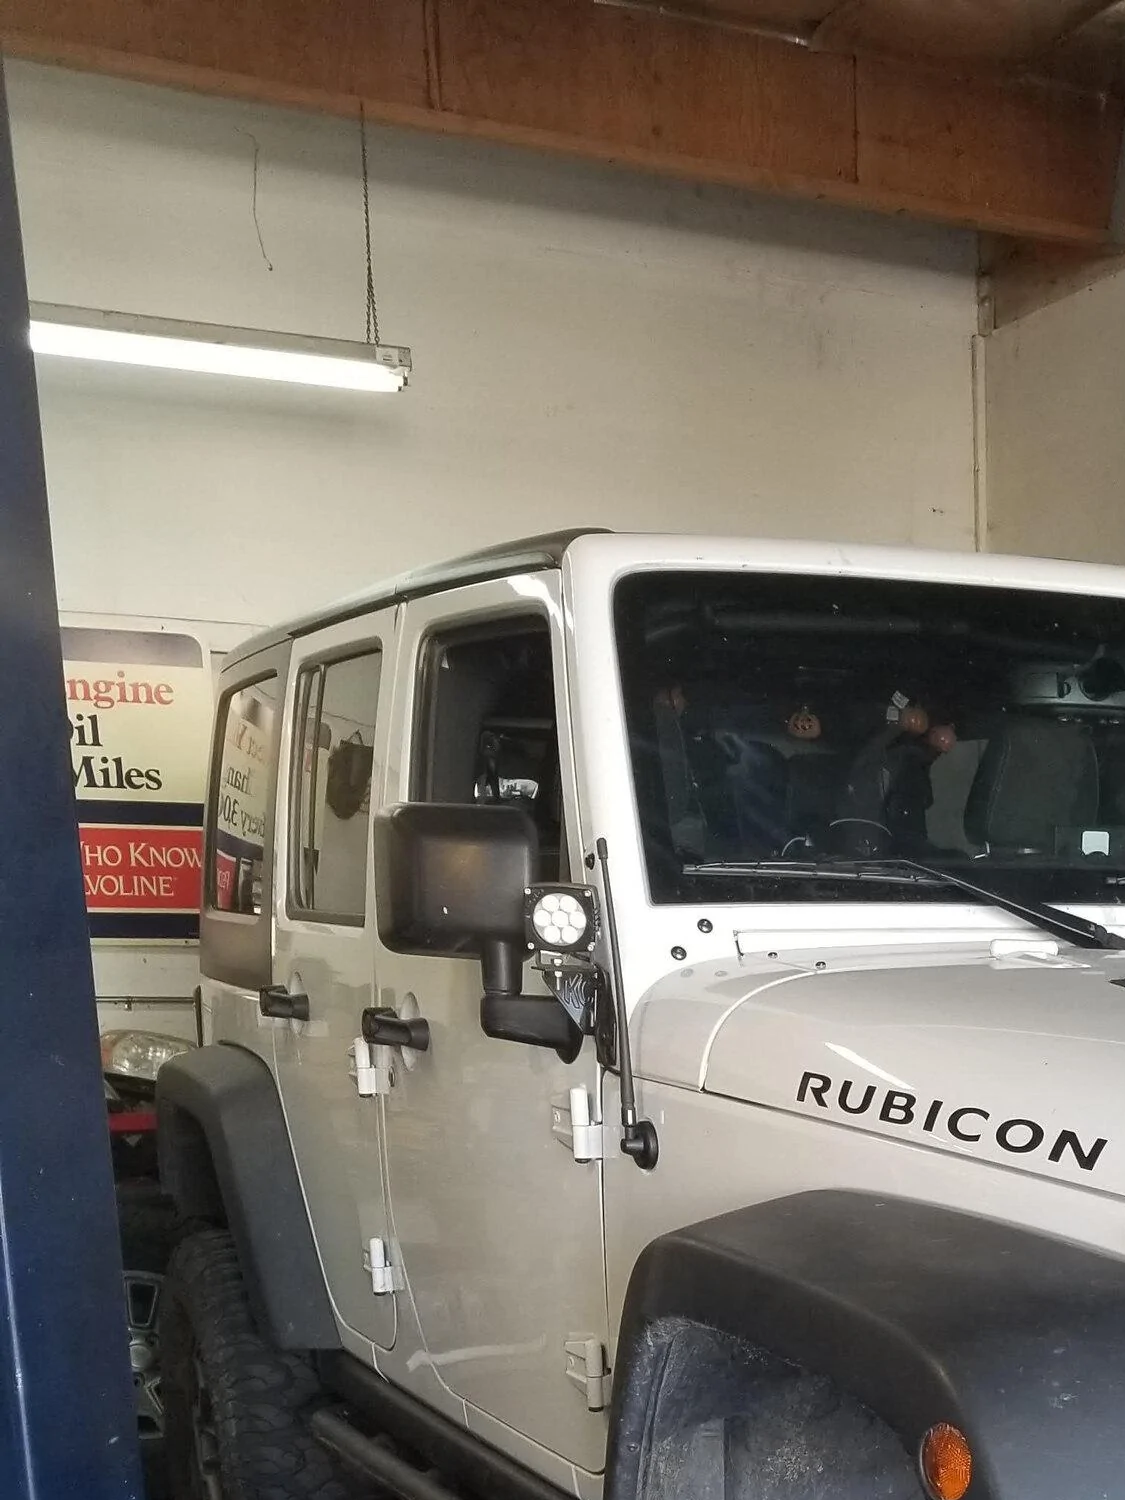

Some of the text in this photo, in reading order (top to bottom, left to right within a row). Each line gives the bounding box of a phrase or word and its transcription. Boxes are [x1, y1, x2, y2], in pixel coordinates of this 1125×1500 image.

[67, 671, 174, 709] ngine
[69, 713, 103, 747] il
[72, 755, 163, 791] Miles
[80, 841, 202, 868] HO KNOW
[84, 875, 175, 897] VOLINE
[796, 1071, 1109, 1172] RUBICON
